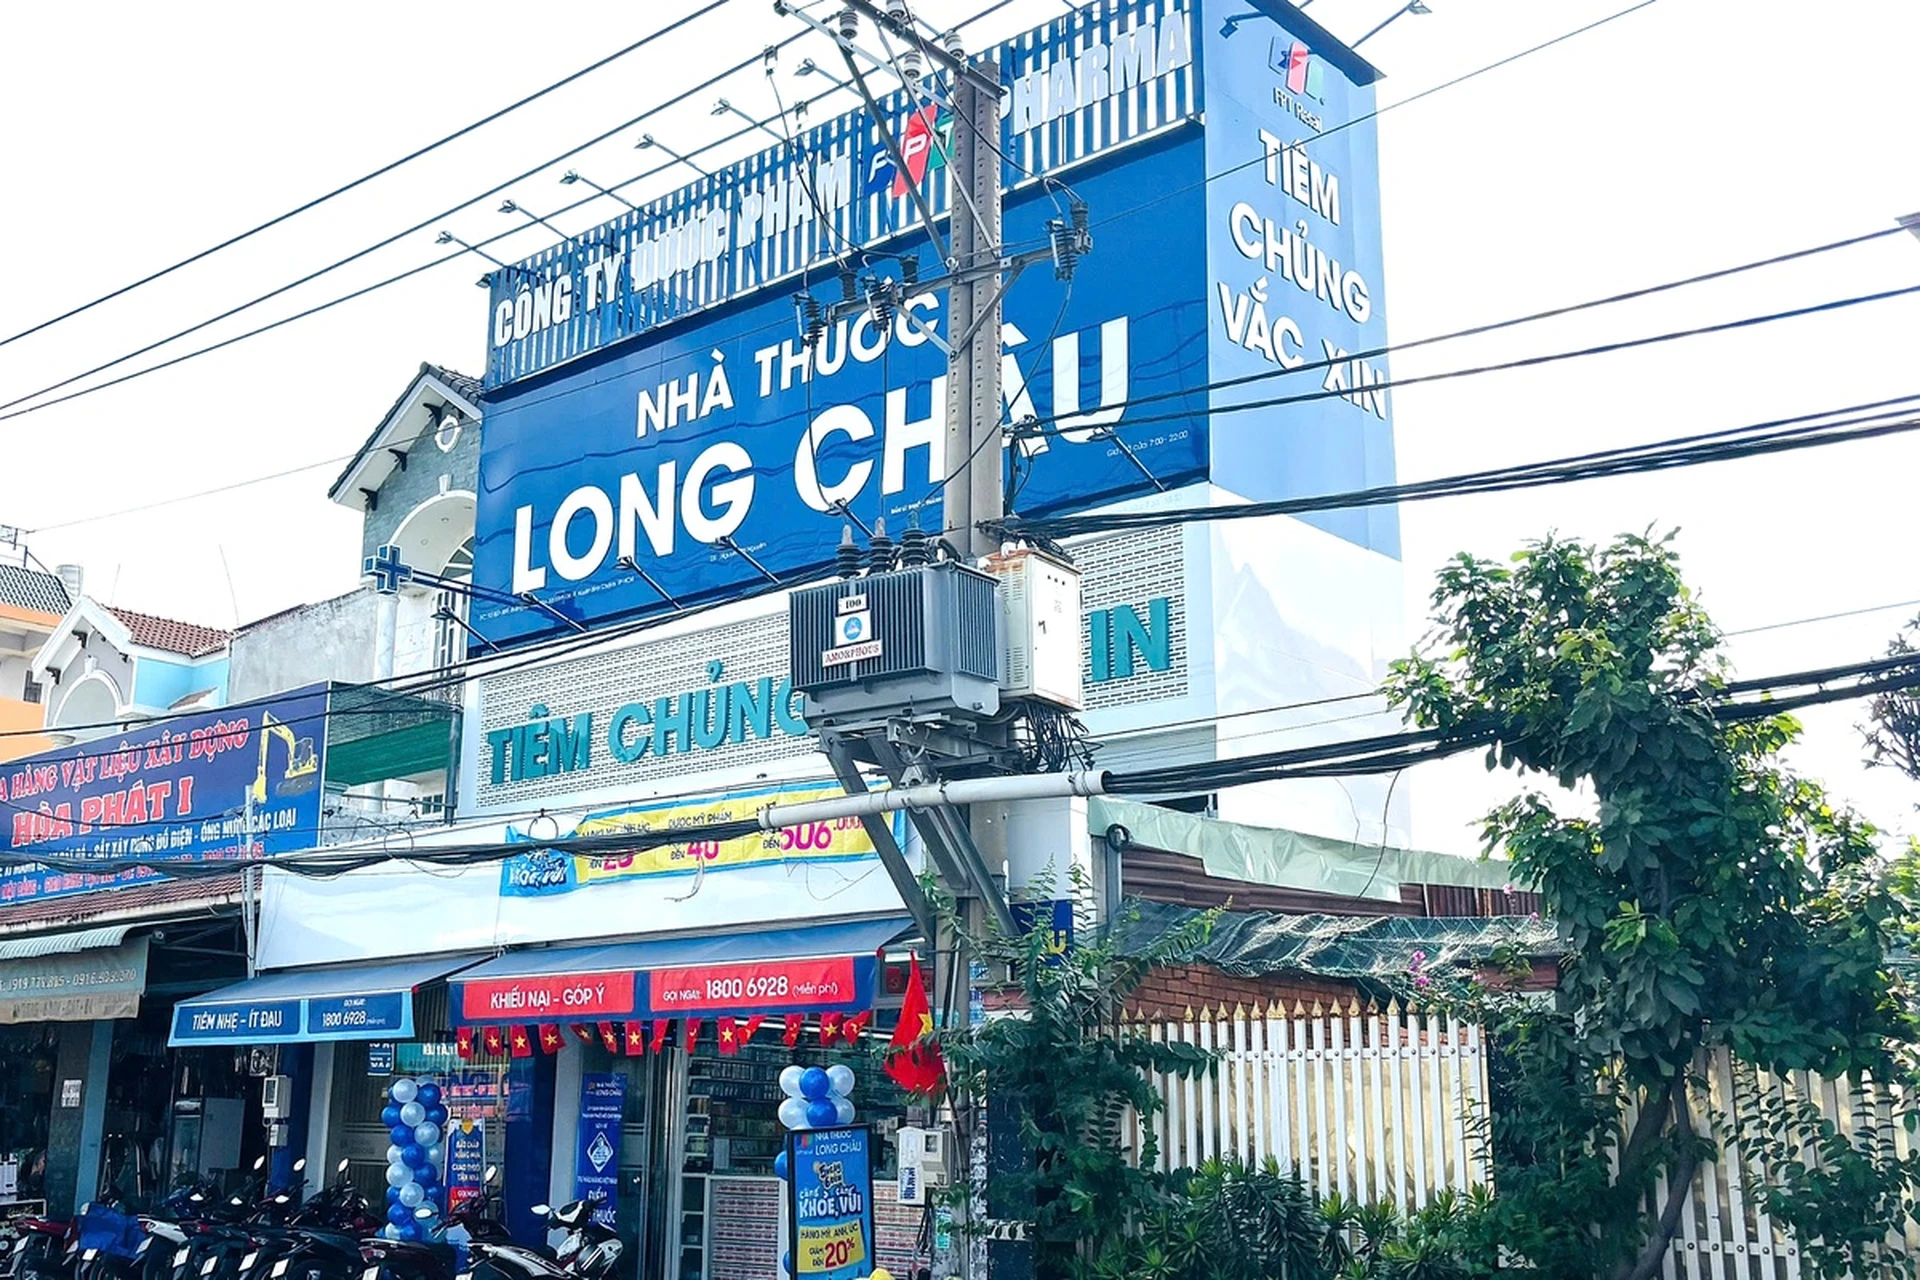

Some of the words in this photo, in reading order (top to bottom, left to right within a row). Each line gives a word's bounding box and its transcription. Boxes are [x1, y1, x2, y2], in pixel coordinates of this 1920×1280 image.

[1259, 128, 1340, 227] TIÊM
[494, 273, 573, 348] CÔNG
[583, 252, 623, 313] TY
[867, 112, 954, 184] FPT
[1229, 202, 1371, 324] CHỦNG
[1217, 276, 1304, 372] VẮC
[1321, 338, 1386, 420] XIN
[636, 347, 735, 439] NHÀ
[512, 441, 756, 597] LONG
[845, 599, 862, 609] 100
[12, 763, 57, 799] HÀNG
[61, 750, 98, 793] VẬT
[99, 740, 142, 783] LIỆU
[144, 729, 187, 769] XÂY
[487, 703, 593, 785] TIÊM
[78, 778, 172, 836] PHÁT
[177, 775, 194, 816] I
[201, 819, 220, 842] ỐNG
[273, 807, 297, 830] LOẠI
[323, 1012, 342, 1028] 1800
[342, 1010, 366, 1026] 6928
[490, 985, 525, 1009] KHIẾU
[527, 989, 550, 1012] NẠI
[563, 983, 593, 1006] GÓP
[595, 982, 605, 1004] Ý
[662, 990, 678, 1004] GỌI
[705, 979, 742, 999] 1800
[746, 975, 788, 997] 6928
[216, 1012, 239, 1033] NHẸ
[248, 1008, 259, 1028] ÍT
[260, 1009, 282, 1028] ĐAU
[815, 1143, 839, 1156] LONG
[840, 1139, 862, 1153] CHÂU
[824, 1238, 856, 1269] 20%
